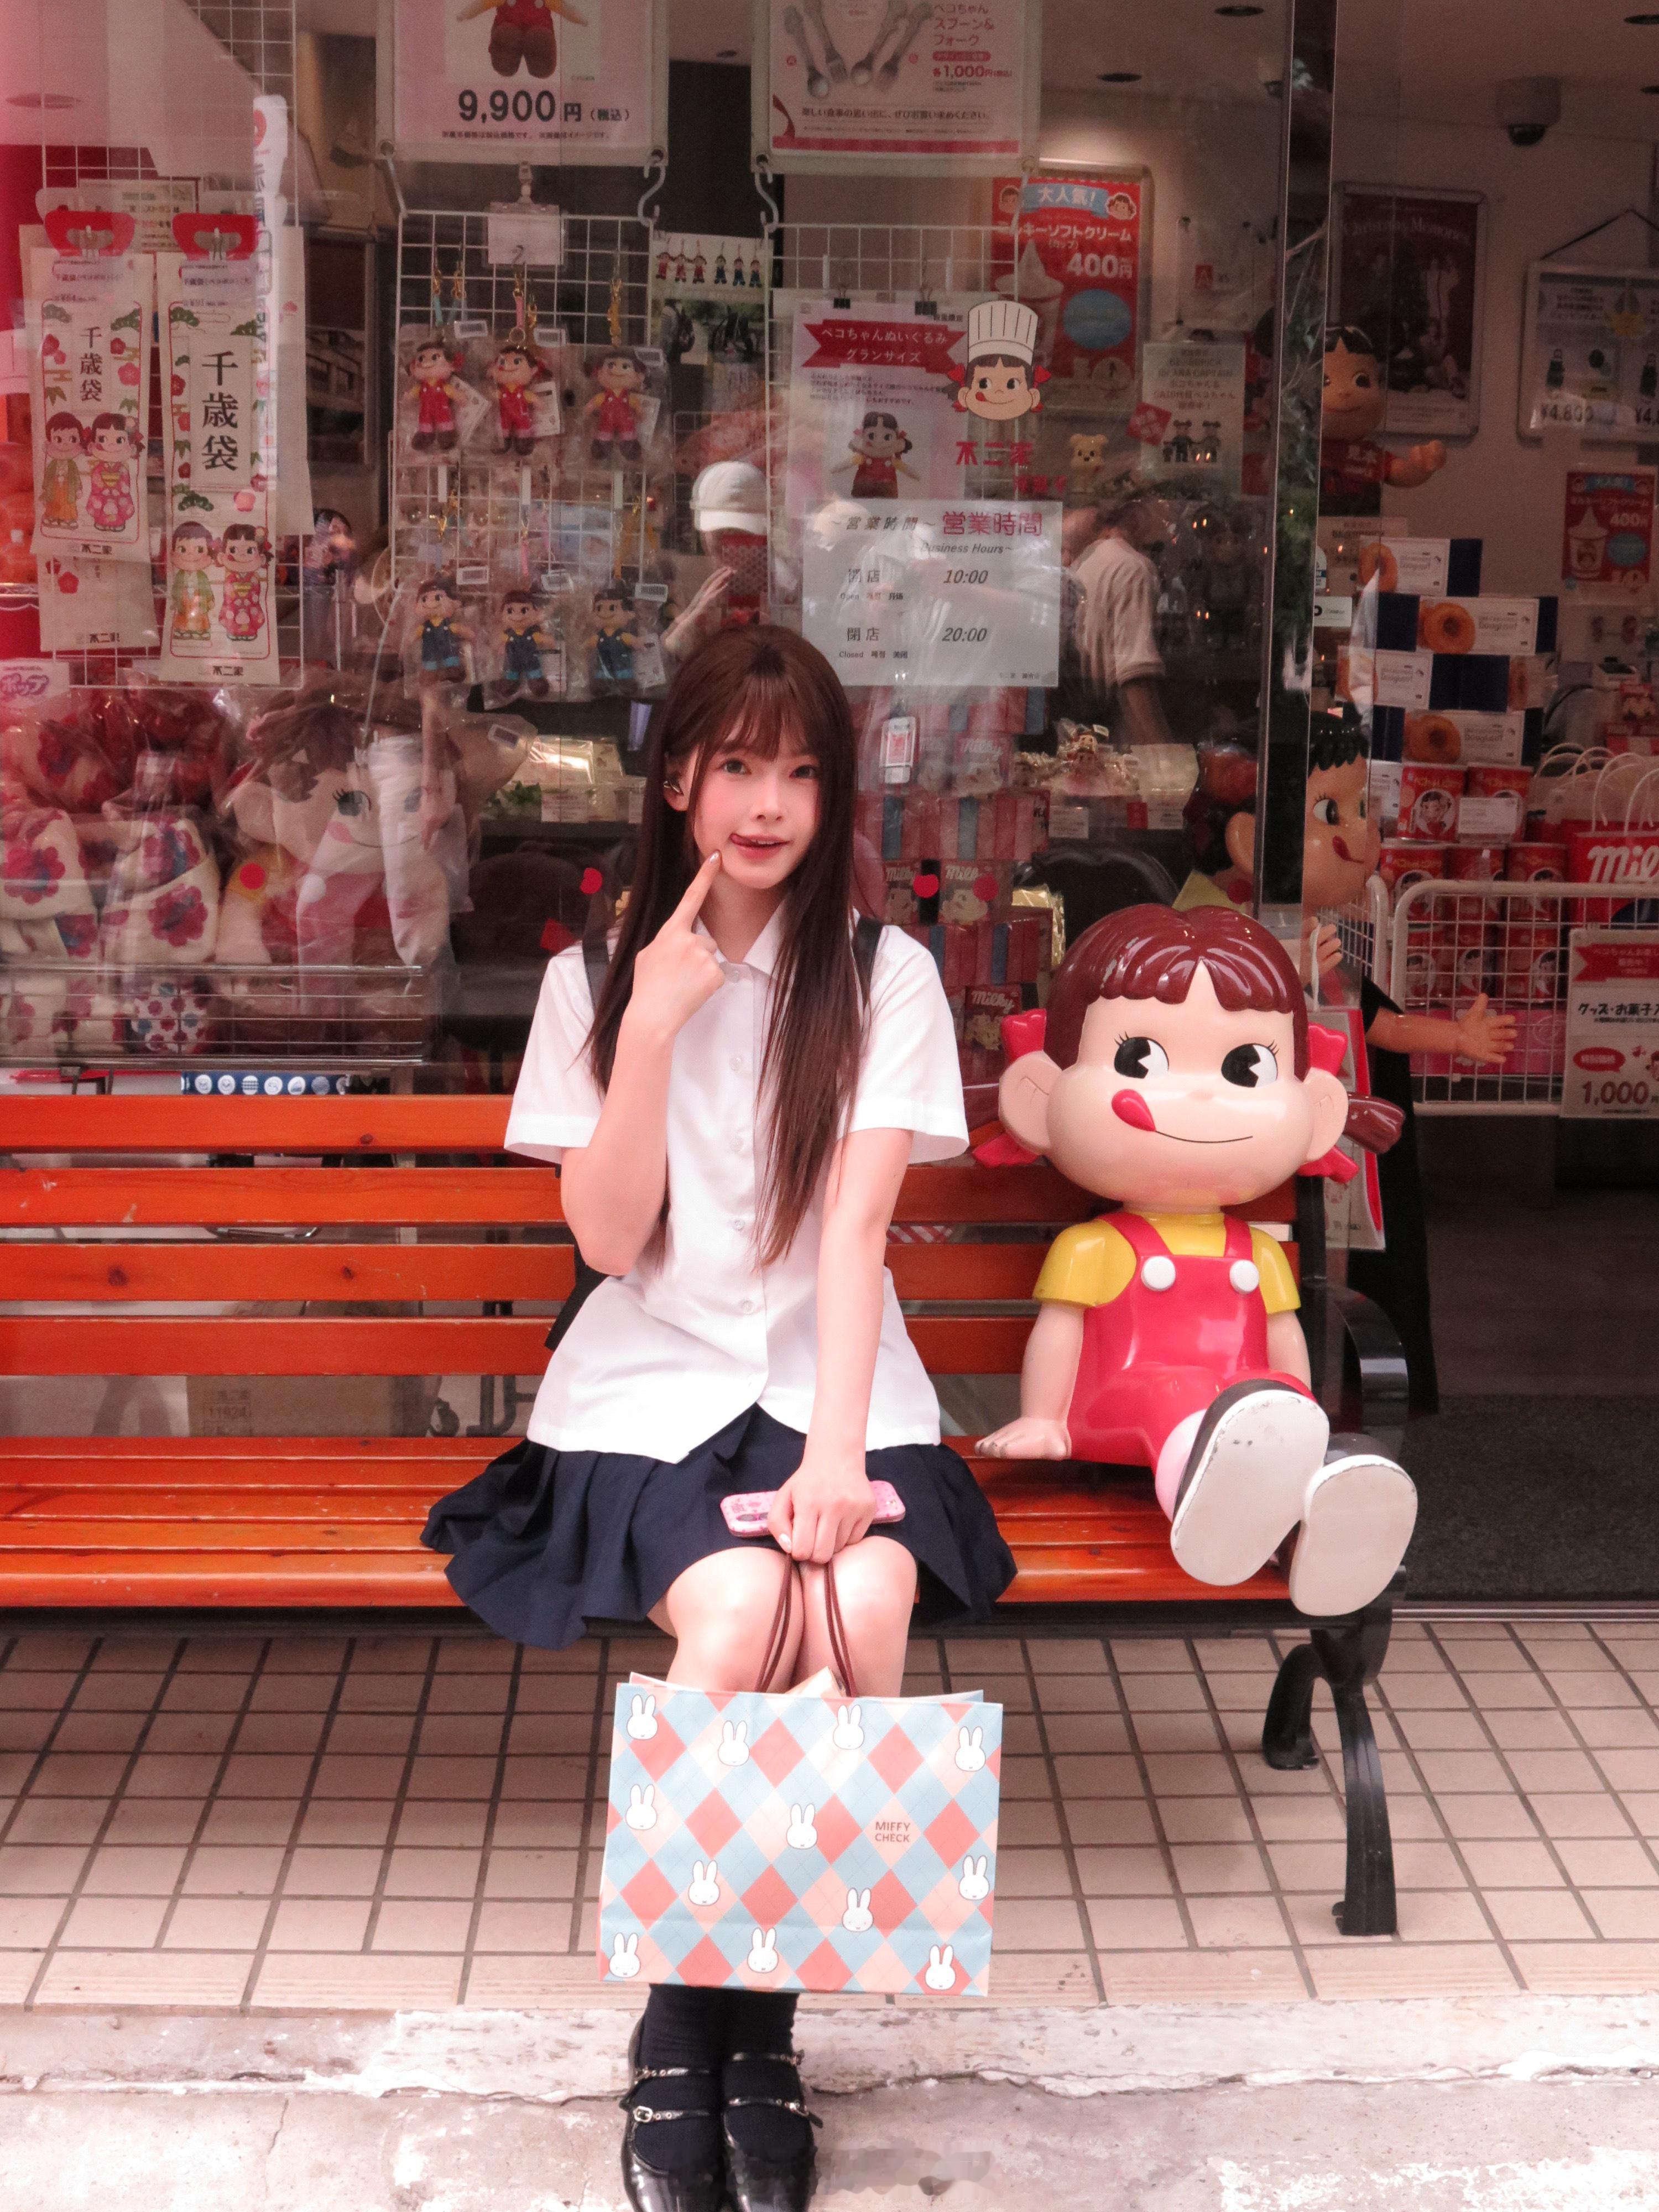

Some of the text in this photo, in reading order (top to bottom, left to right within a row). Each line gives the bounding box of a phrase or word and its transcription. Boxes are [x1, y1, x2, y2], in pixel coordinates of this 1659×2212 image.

[1067, 253, 1133, 278] 400円
[846, 348, 921, 363] グランサイズ
[80, 326, 104, 403] 千歳袋
[201, 351, 239, 472] 千歳袋
[942, 511, 1042, 537] 営業時間
[943, 569, 989, 585] 10:00
[847, 627, 987, 642] 閉店 20:00
[212, 665, 244, 677] 不二家
[972, 990, 1015, 1015] Milky
[875, 1821, 911, 1832] MIFFY
[875, 1833, 910, 1843] CHECK
